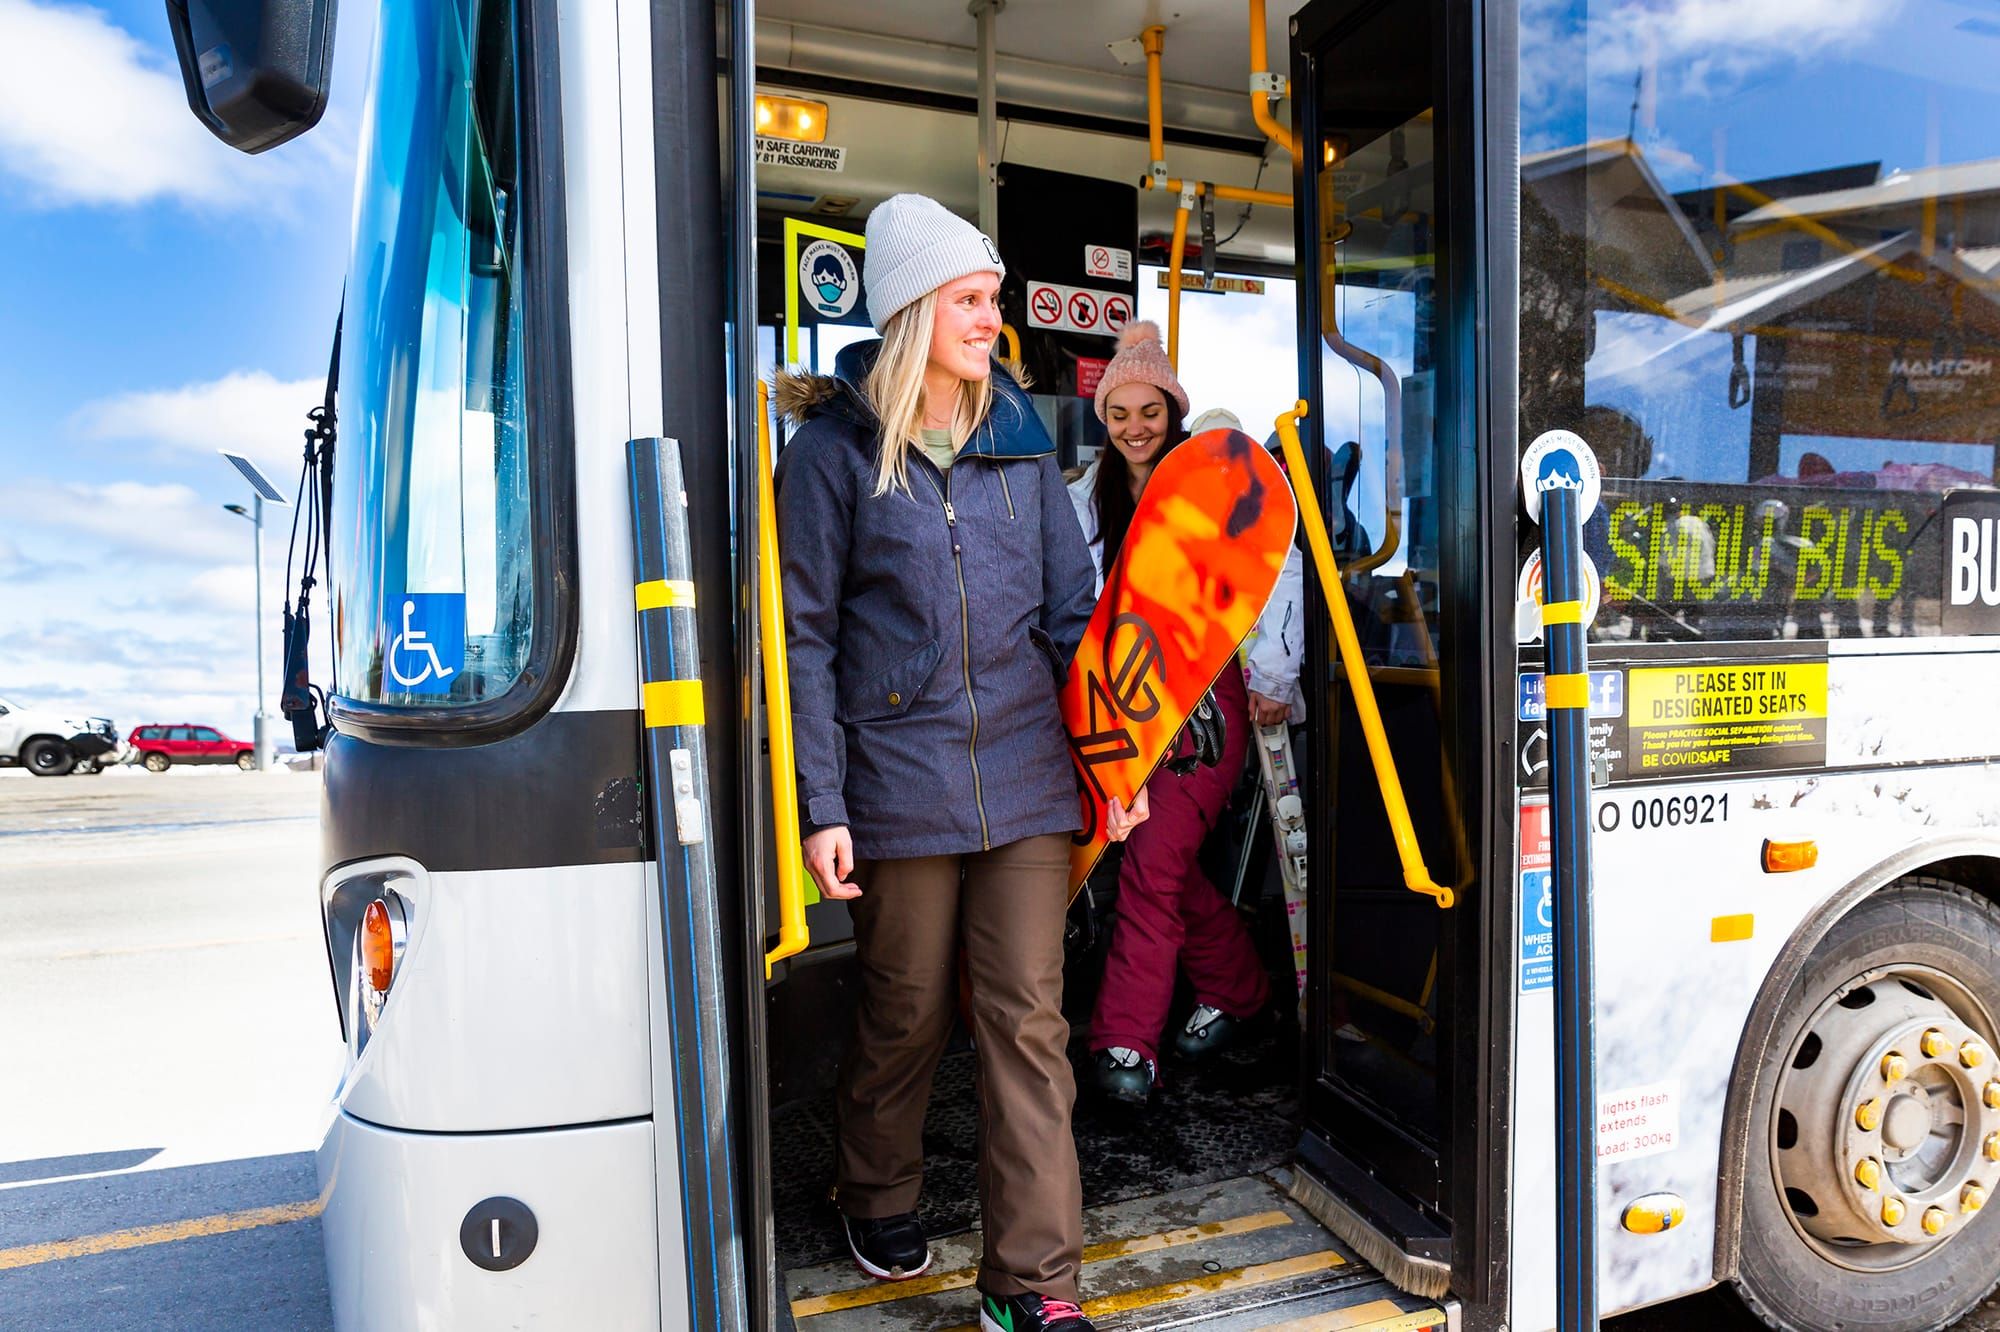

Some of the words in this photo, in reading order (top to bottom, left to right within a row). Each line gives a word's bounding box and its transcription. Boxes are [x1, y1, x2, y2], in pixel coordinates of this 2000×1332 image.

[766, 141, 791, 154] SAFE
[793, 144, 841, 159] CARRYING
[763, 153, 774, 163] 81
[777, 154, 838, 170] PASSENGERS
[802, 256, 810, 272] FACE
[809, 244, 825, 256] MASKS
[826, 244, 840, 253] MUST
[1217, 278, 1235, 290] EXIT
[1604, 501, 1775, 601] SNOW
[1795, 505, 1909, 600] BUS
[1675, 672, 1736, 693] PLEASE
[1742, 671, 1765, 691] SIT
[1771, 671, 1786, 690] IN
[1653, 695, 1753, 719] DESIGNATED
[1759, 693, 1807, 714] SEATS
[1643, 741, 1665, 750] Thank
[1666, 742, 1680, 750] you
[1680, 739, 1692, 748] for
[1692, 740, 1709, 749] your
[1710, 735, 1760, 747] understanding
[1761, 734, 1784, 744] during
[1784, 732, 1797, 741] this
[1668, 728, 1703, 738] PRACTICE
[1704, 727, 1729, 736] SOCIAL
[1730, 725, 1773, 736] SEPARATION
[1643, 754, 1658, 767] BE
[1662, 750, 1730, 766] COVIDSAFE
[1632, 793, 1728, 829] 006921
[1603, 1100, 1636, 1116] lights
[1640, 1093, 1669, 1107] flash
[1600, 1114, 1647, 1133] extends
[1597, 1140, 1629, 1157] Load:
[1633, 1132, 1671, 1149] 300kg
